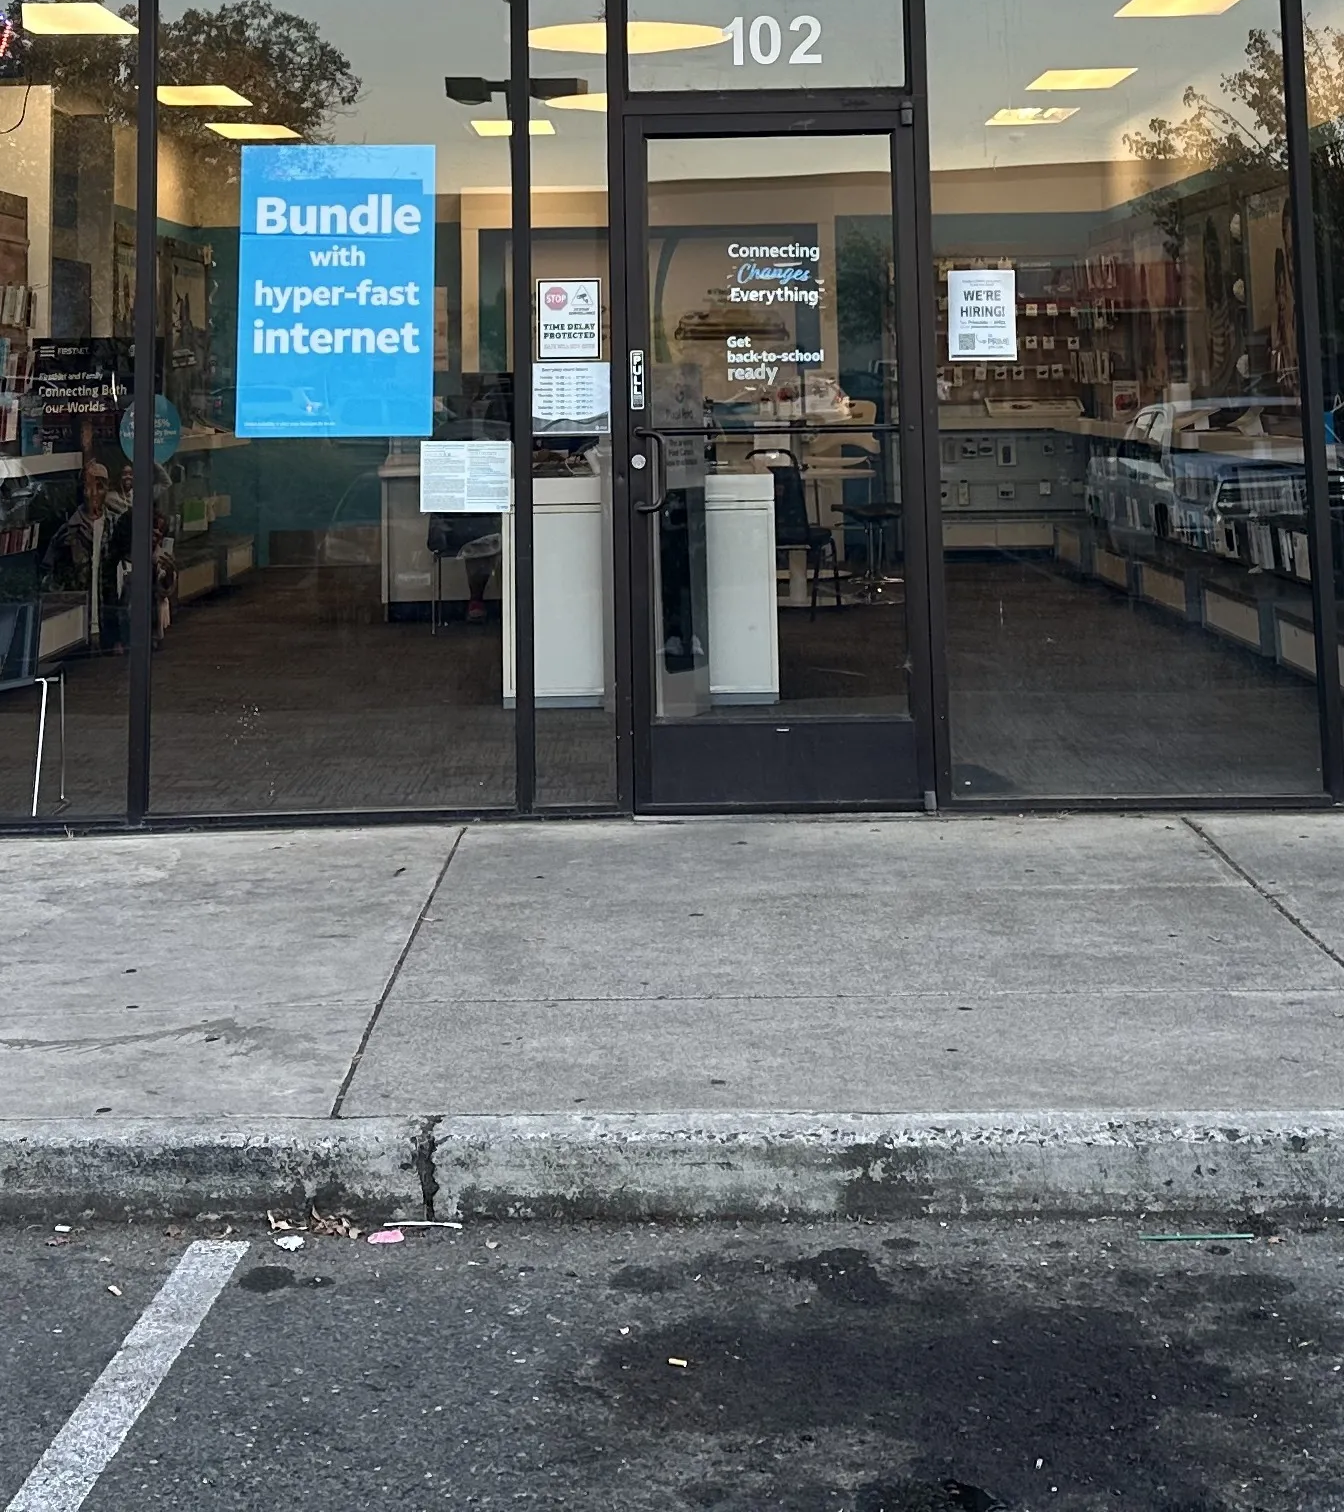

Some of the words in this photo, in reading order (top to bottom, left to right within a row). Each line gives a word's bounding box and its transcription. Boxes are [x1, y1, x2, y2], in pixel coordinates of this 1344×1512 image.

[722, 15, 822, 65] 102
[256, 193, 422, 235] Bundle
[309, 245, 366, 267] with
[727, 242, 821, 262] Connecting
[736, 262, 812, 285] Changes
[254, 278, 421, 314] hyper-fast
[546, 294, 566, 304] STOP
[730, 286, 820, 306] Everything
[963, 290, 1002, 302] WE'RE
[960, 306, 1006, 318] HIRING!
[253, 318, 421, 355] internet
[543, 323, 566, 331] TIME
[543, 332, 596, 340] PROTECTED
[726, 335, 752, 348] Get
[726, 349, 825, 364] back-to-school
[632, 355, 643, 395] PULL
[727, 363, 779, 386] ready
[38, 384, 100, 399] Connecting
[67, 400, 106, 413] Worlds
